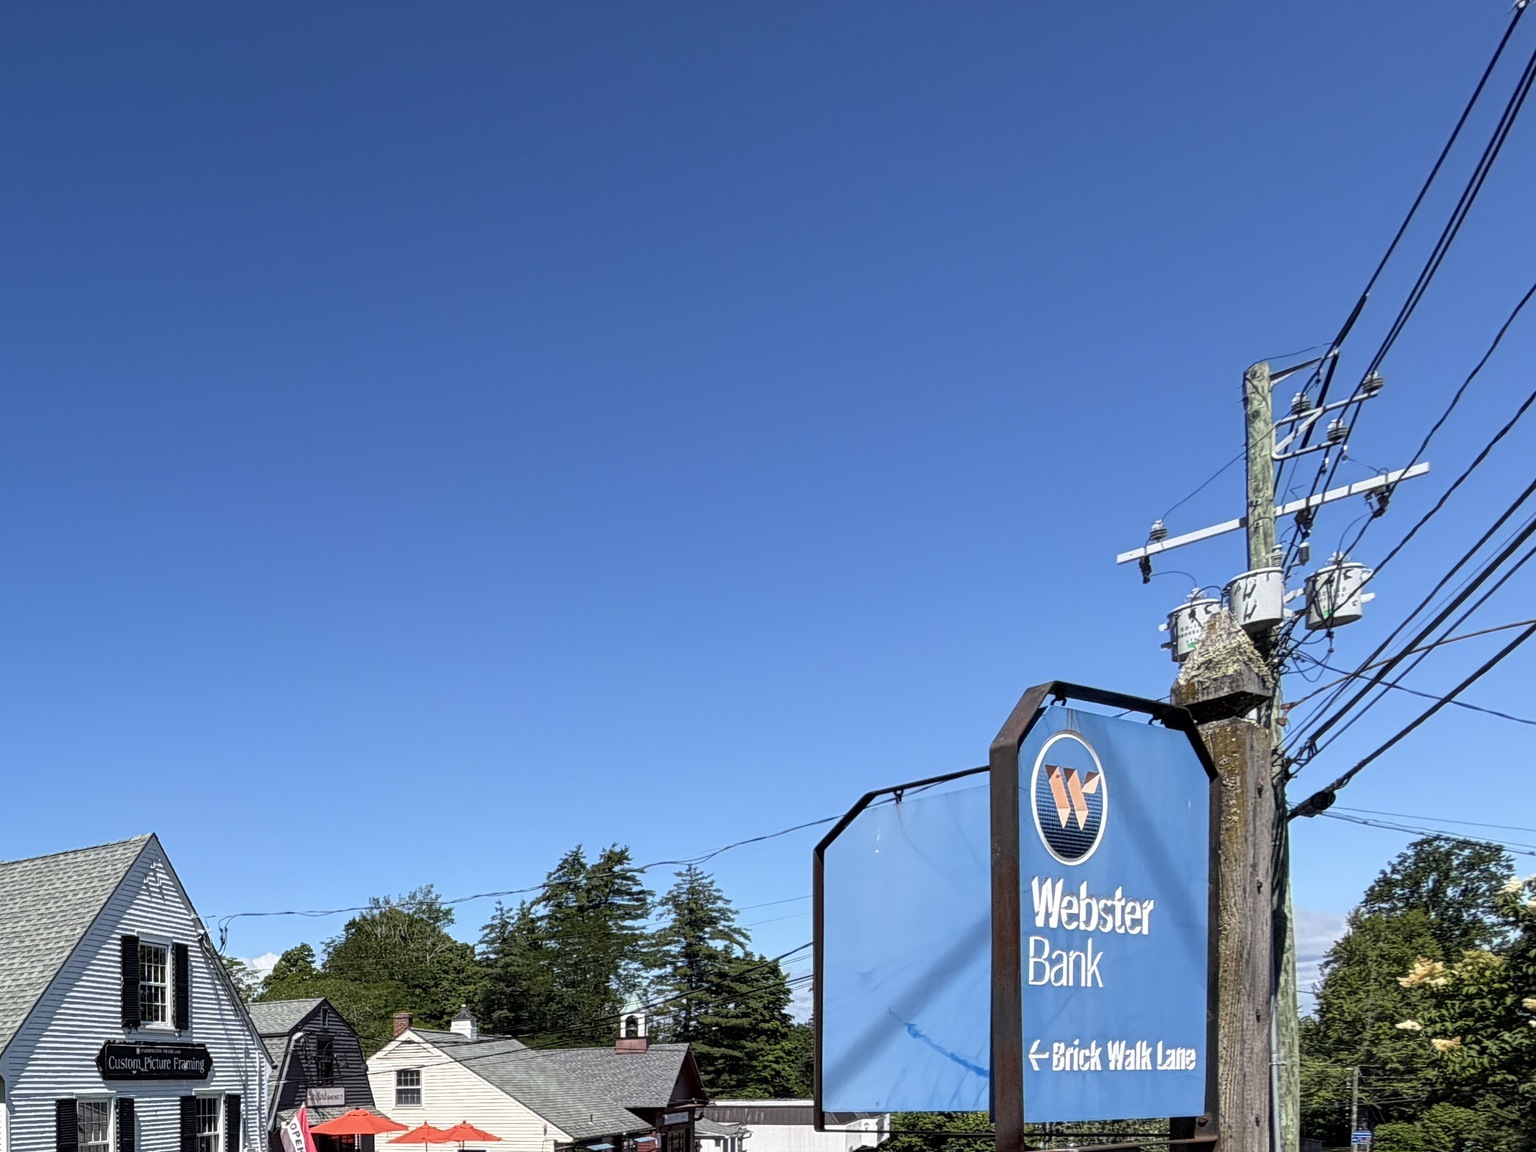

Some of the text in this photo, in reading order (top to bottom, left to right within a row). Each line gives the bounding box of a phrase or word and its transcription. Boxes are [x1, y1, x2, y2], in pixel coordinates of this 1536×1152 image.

[1031, 876, 1154, 935] Webster
[1028, 935, 1105, 988] Bank
[108, 1055, 205, 1074] Custom Picture Framing
[1052, 1038, 1197, 1072] Brick Walk Lane
